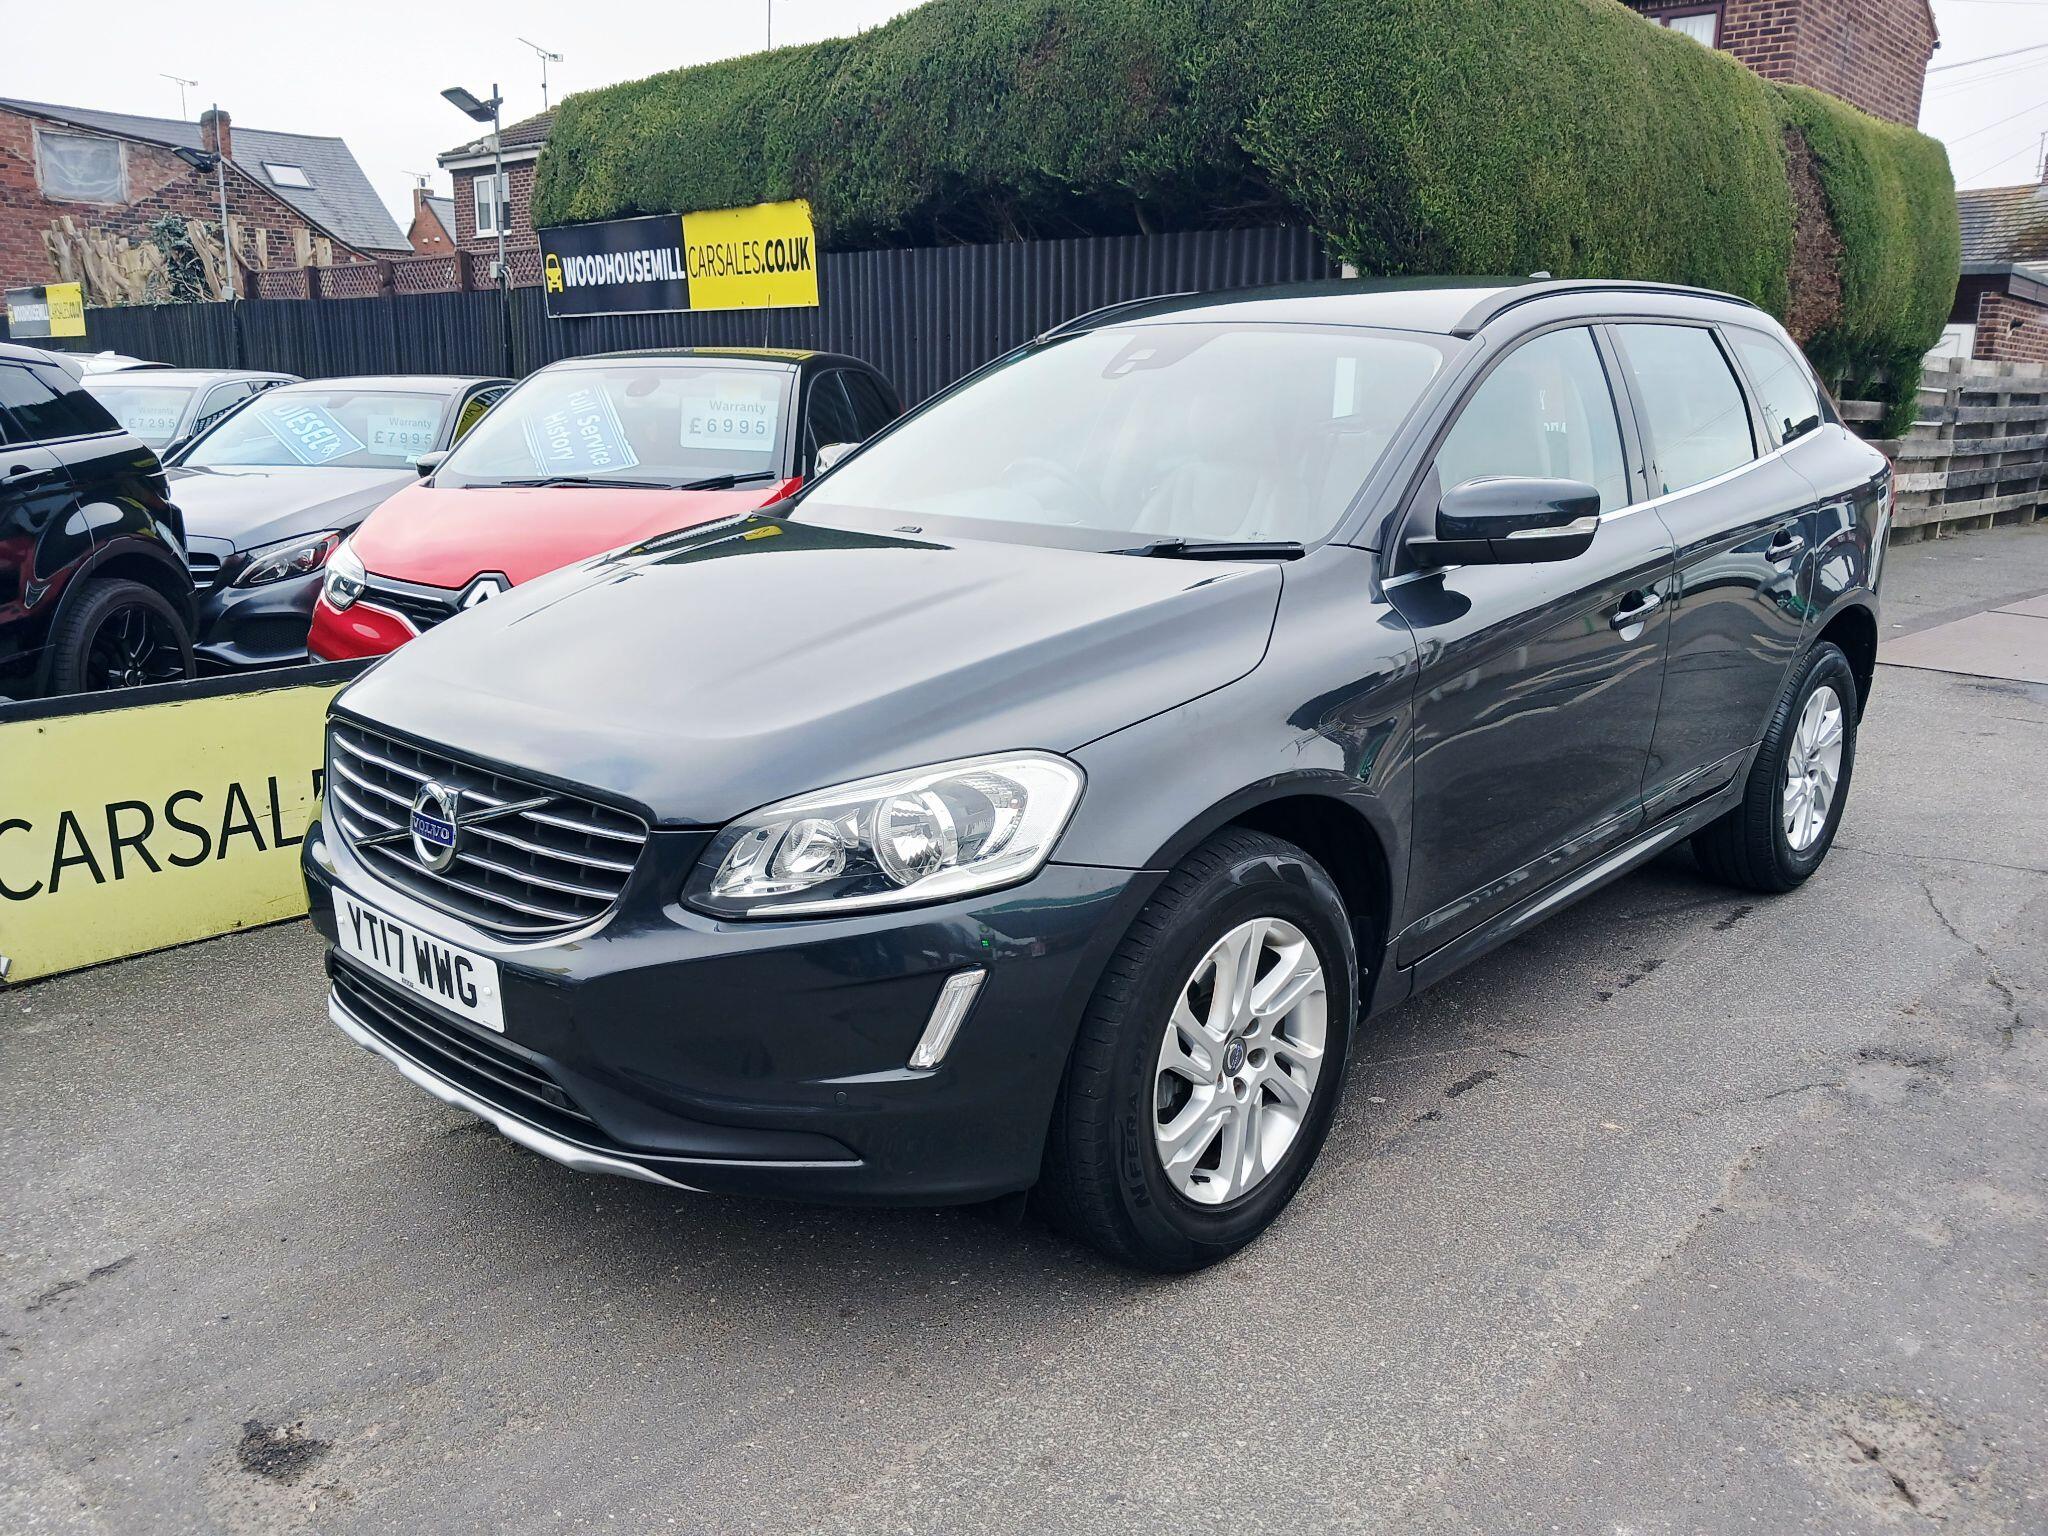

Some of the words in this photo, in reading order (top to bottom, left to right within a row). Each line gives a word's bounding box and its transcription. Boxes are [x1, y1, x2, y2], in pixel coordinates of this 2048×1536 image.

[562, 247, 686, 287] WOODHOUSEMILL
[688, 236, 811, 279] CARSALES.CO.UK
[388, 416, 431, 429] Warranty
[568, 389, 598, 416] Full
[708, 399, 766, 414] Warranty
[543, 411, 575, 460] History
[576, 413, 612, 466] Service
[0, 768, 325, 901] CARSAL
[412, 815, 450, 840] VOLVO
[347, 901, 404, 975] YT17
[412, 934, 478, 1009] WWG
